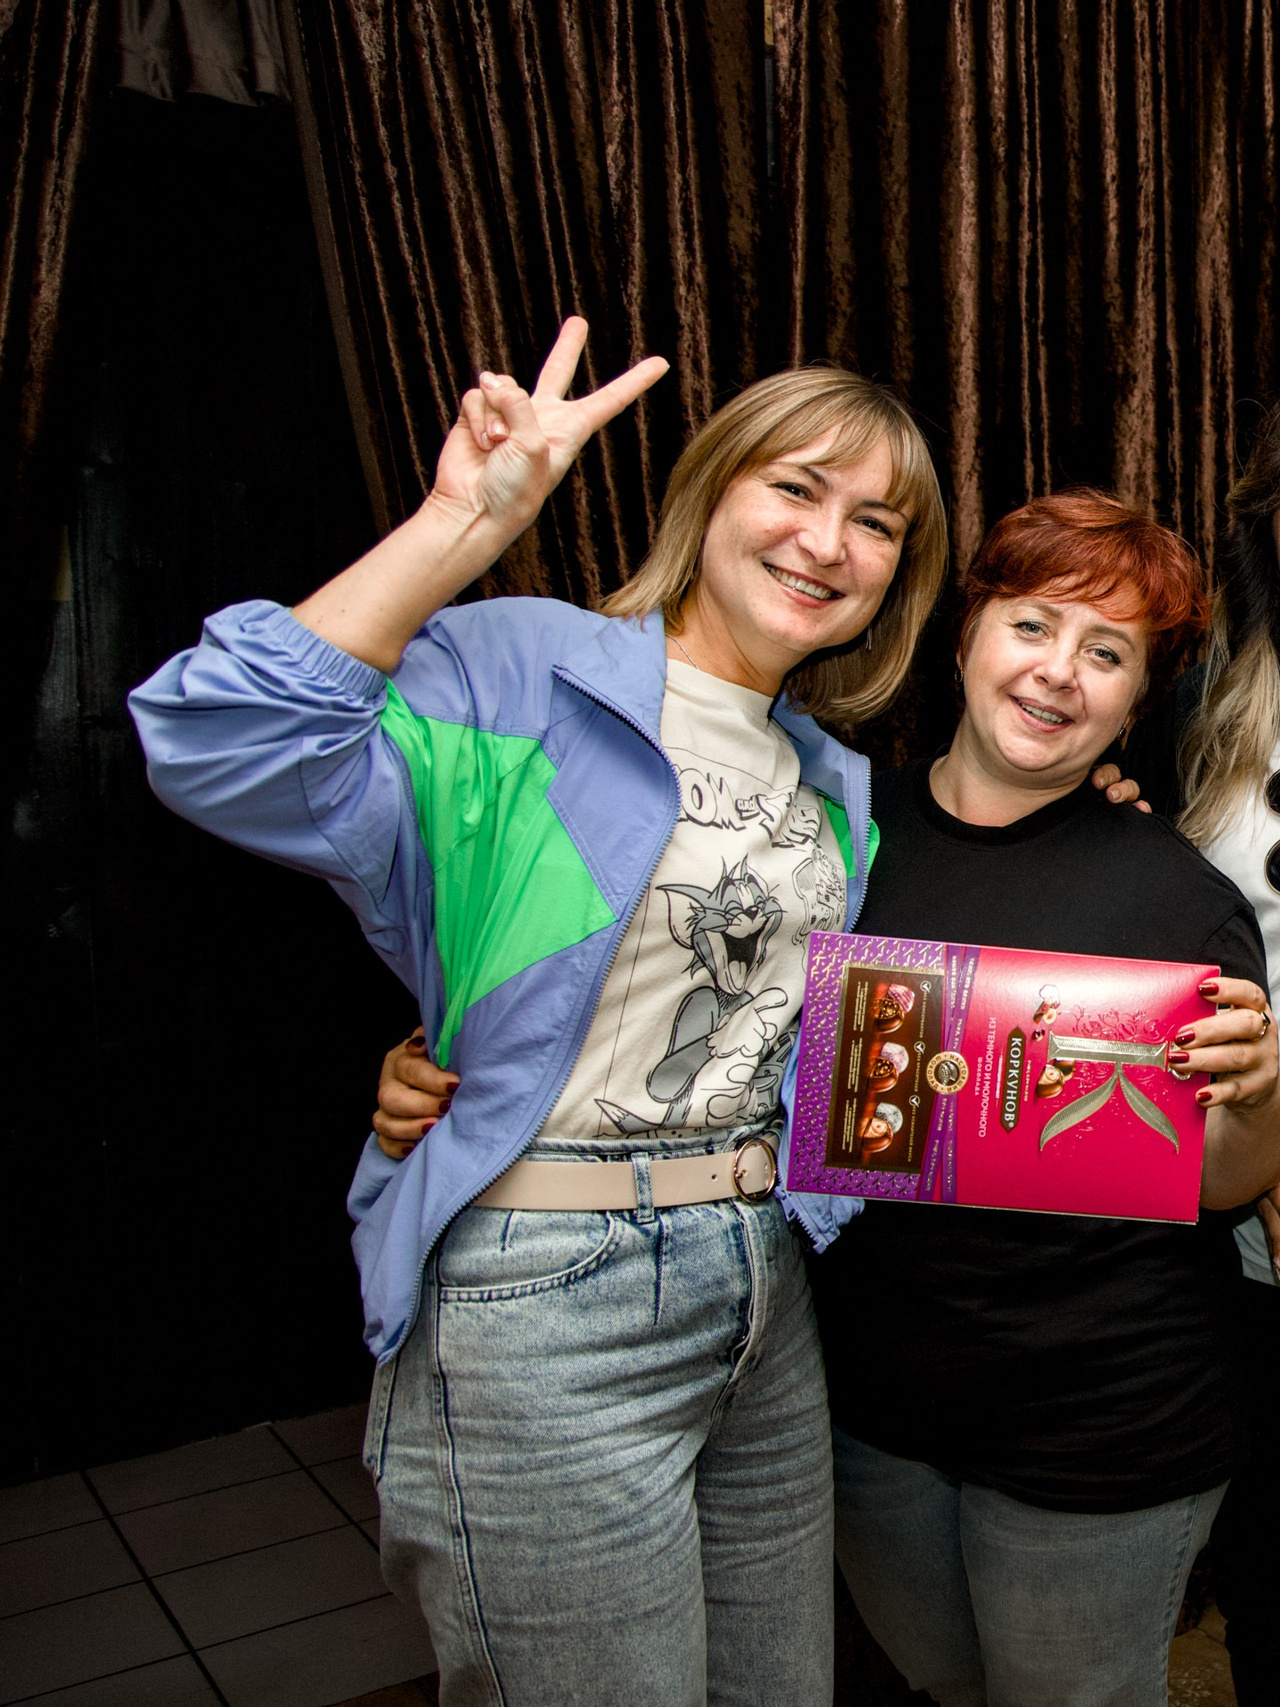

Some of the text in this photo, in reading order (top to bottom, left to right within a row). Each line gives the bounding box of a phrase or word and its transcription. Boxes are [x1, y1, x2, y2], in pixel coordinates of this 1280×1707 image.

[674, 764, 746, 831] OM
[974, 1057, 983, 1096] ШОКОЛАДА
[978, 1016, 997, 1138] ИЗ ТЕМНОГО И МОЛОЧНОГО
